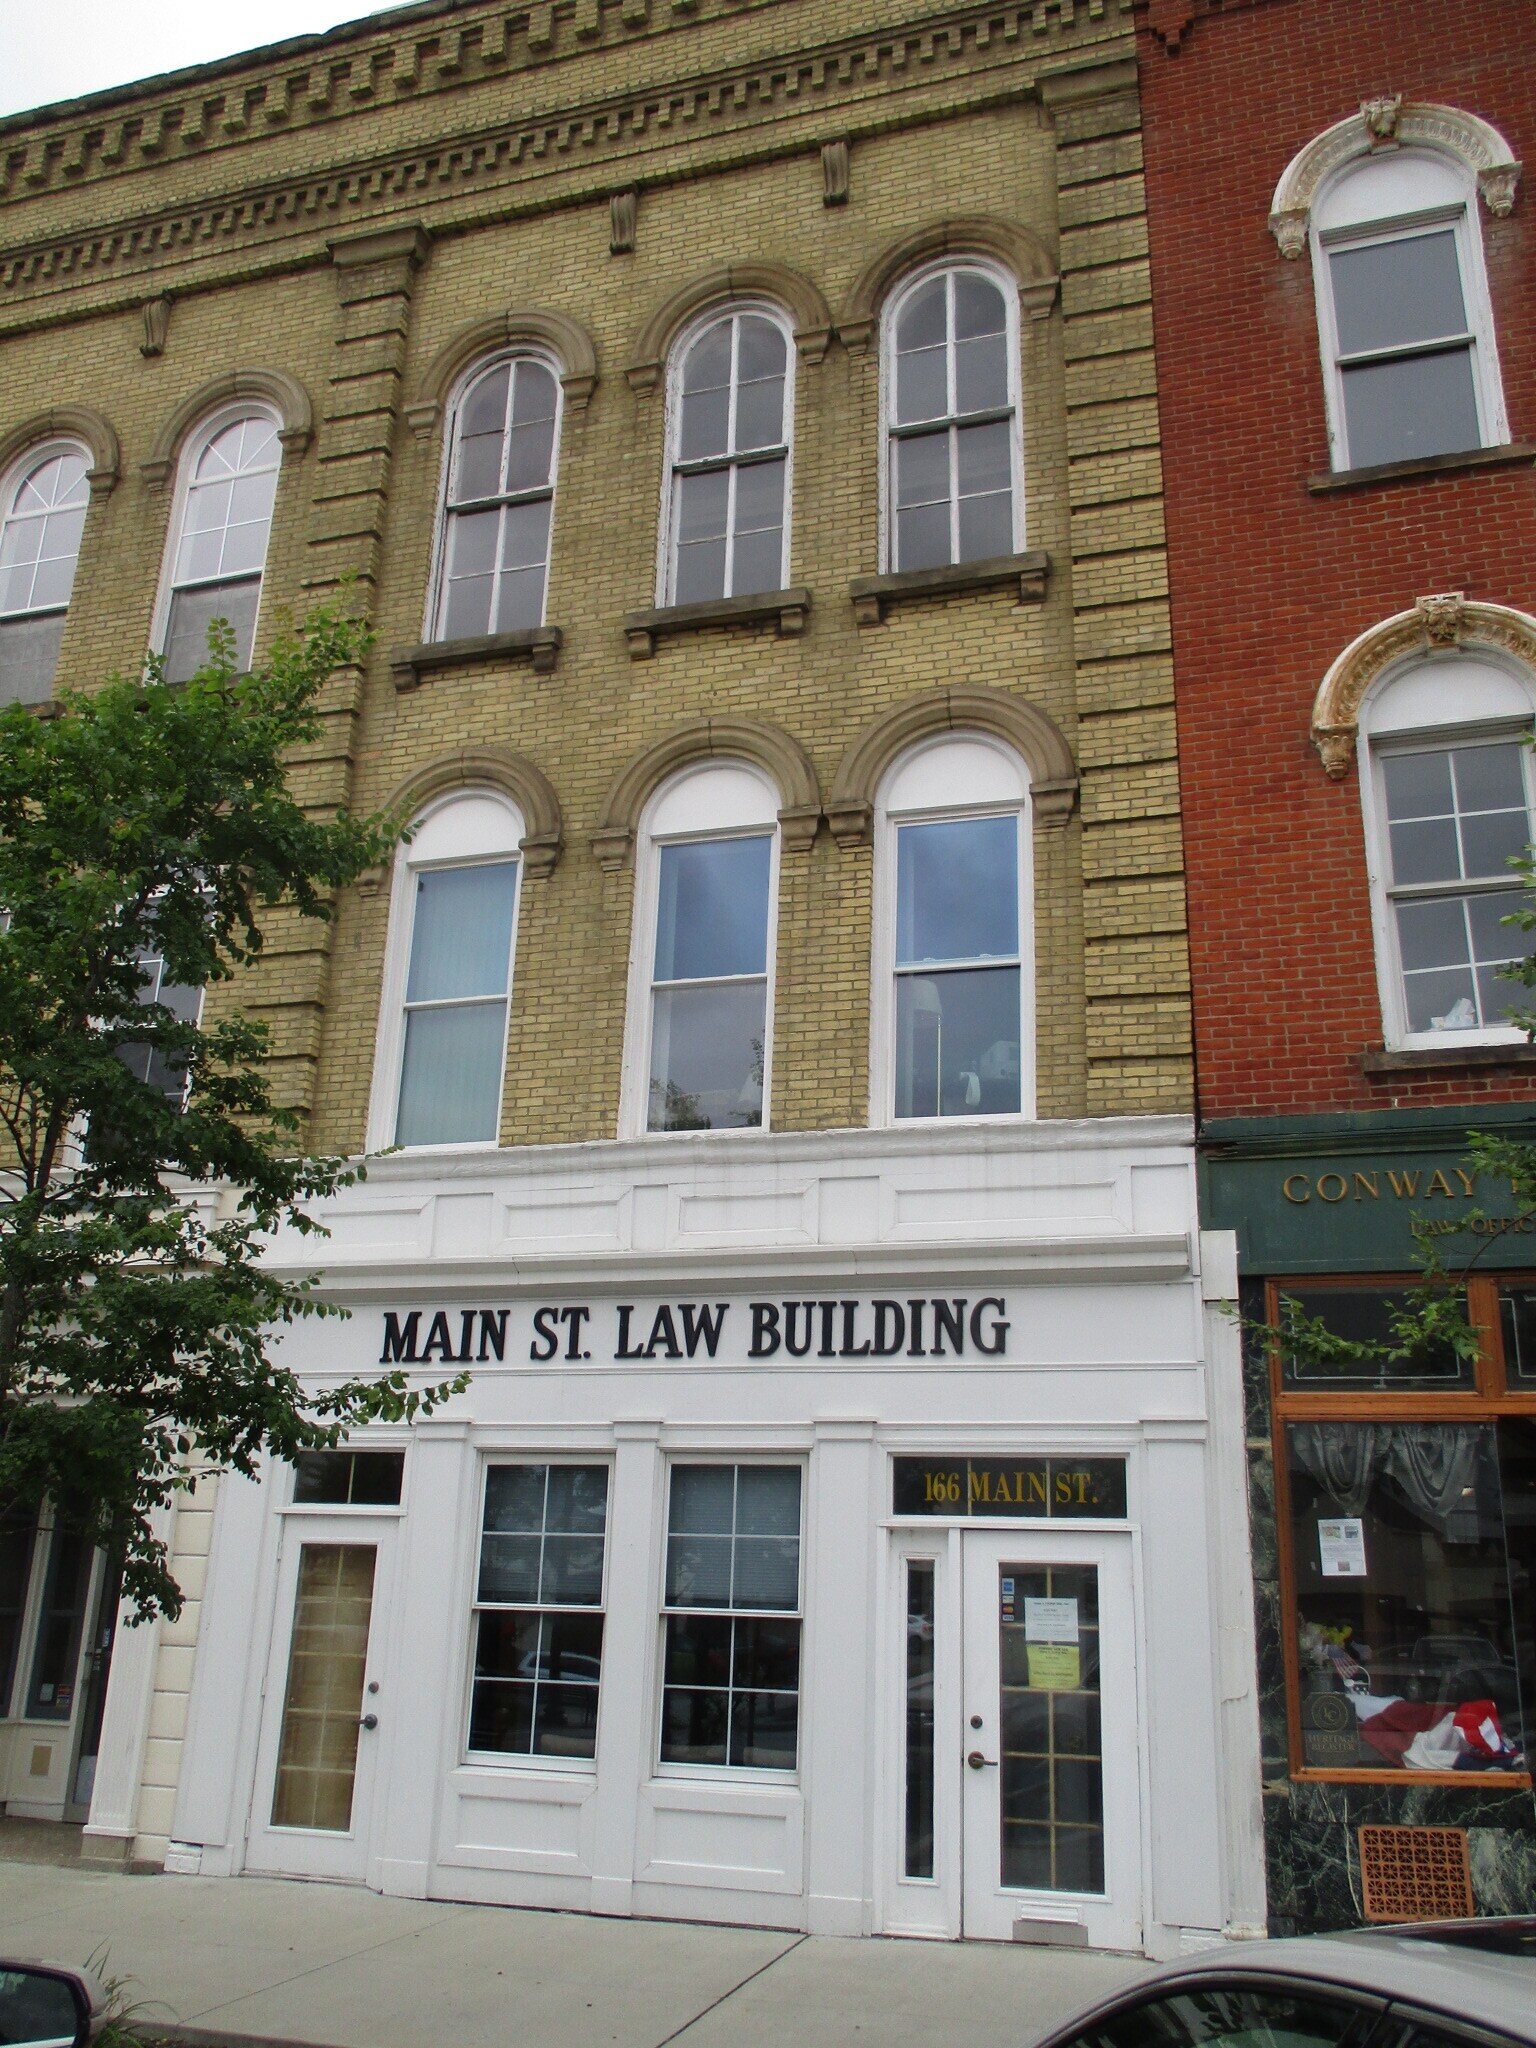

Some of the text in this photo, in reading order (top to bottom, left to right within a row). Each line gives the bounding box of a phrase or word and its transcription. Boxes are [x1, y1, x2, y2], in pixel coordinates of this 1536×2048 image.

[1283, 1168, 1478, 1202] CONWAY
[1471, 1216, 1536, 1234] OFFIC
[380, 1298, 1011, 1363] MAIN ST. LAW BUILDING
[925, 1471, 1099, 1504] 166 MAIN ST.
